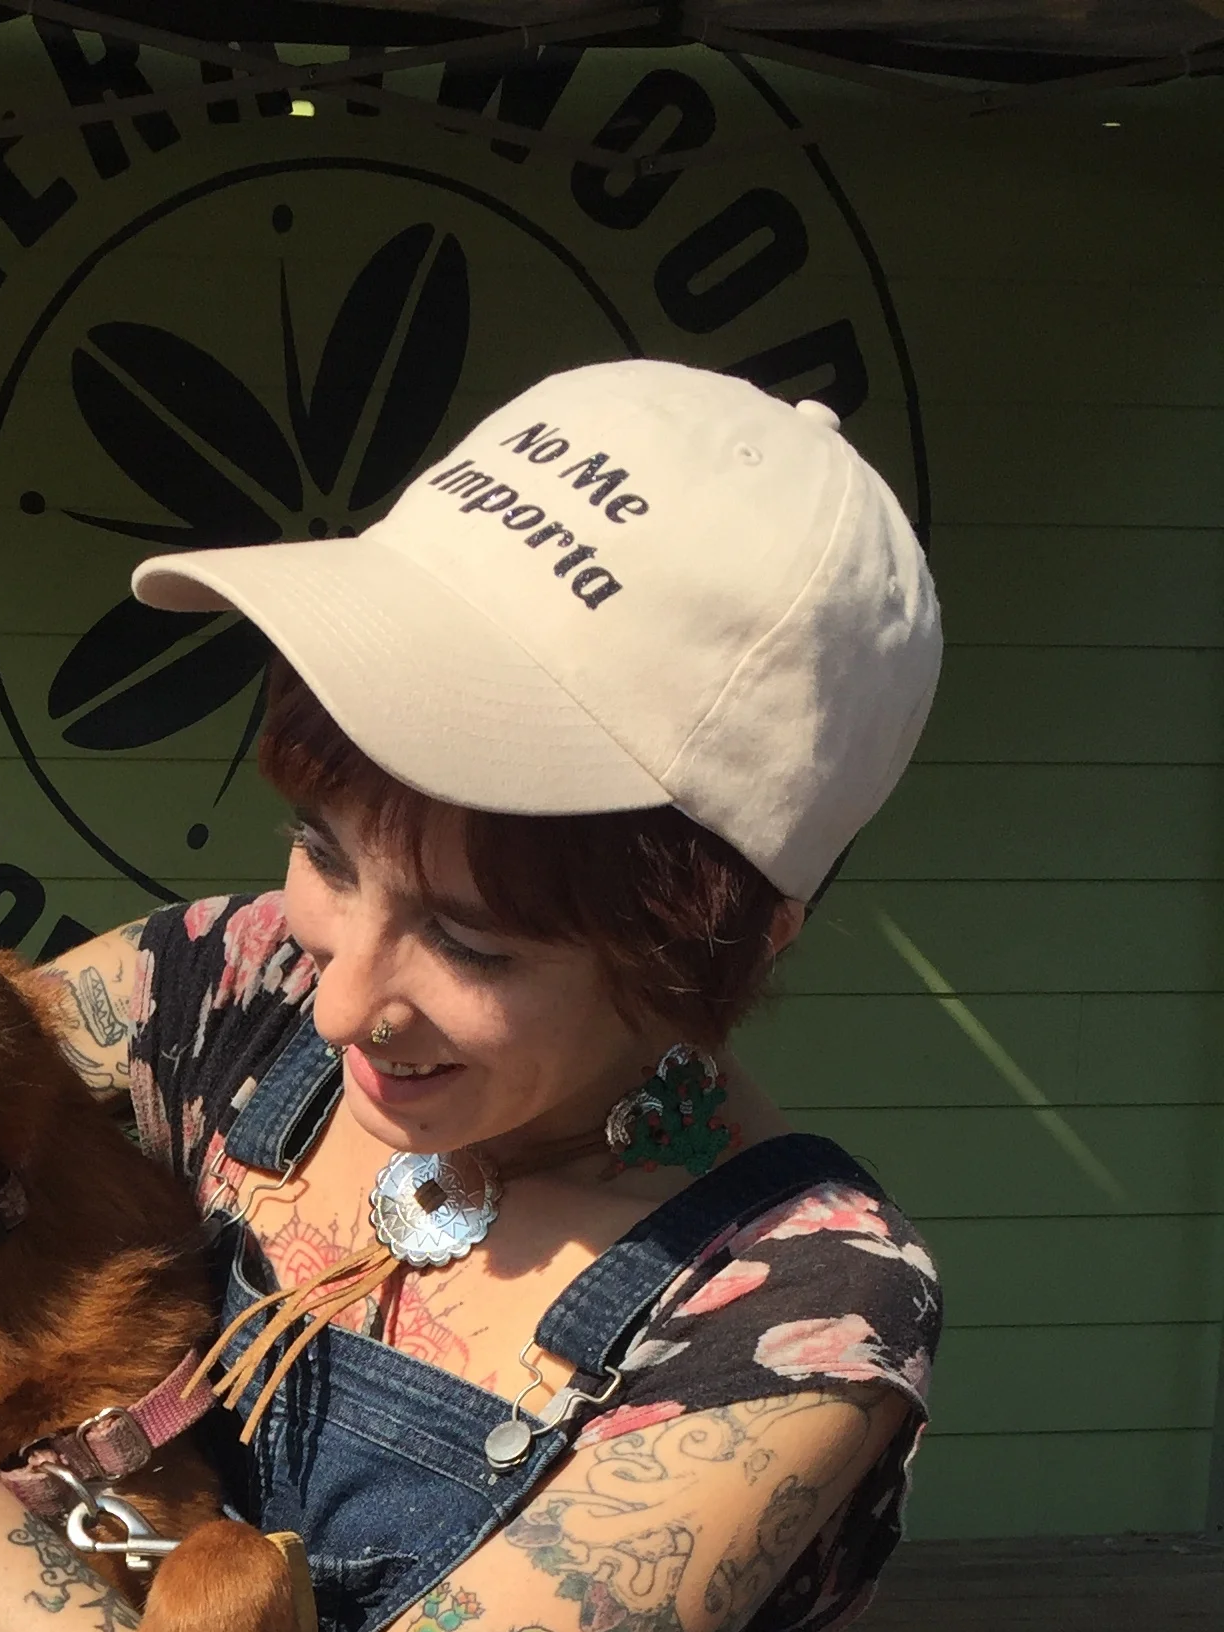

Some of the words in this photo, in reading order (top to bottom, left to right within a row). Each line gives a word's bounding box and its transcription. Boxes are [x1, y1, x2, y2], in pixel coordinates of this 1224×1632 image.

[427, 459, 624, 611] Importa
[498, 421, 570, 464] No
[557, 451, 650, 524] Me
